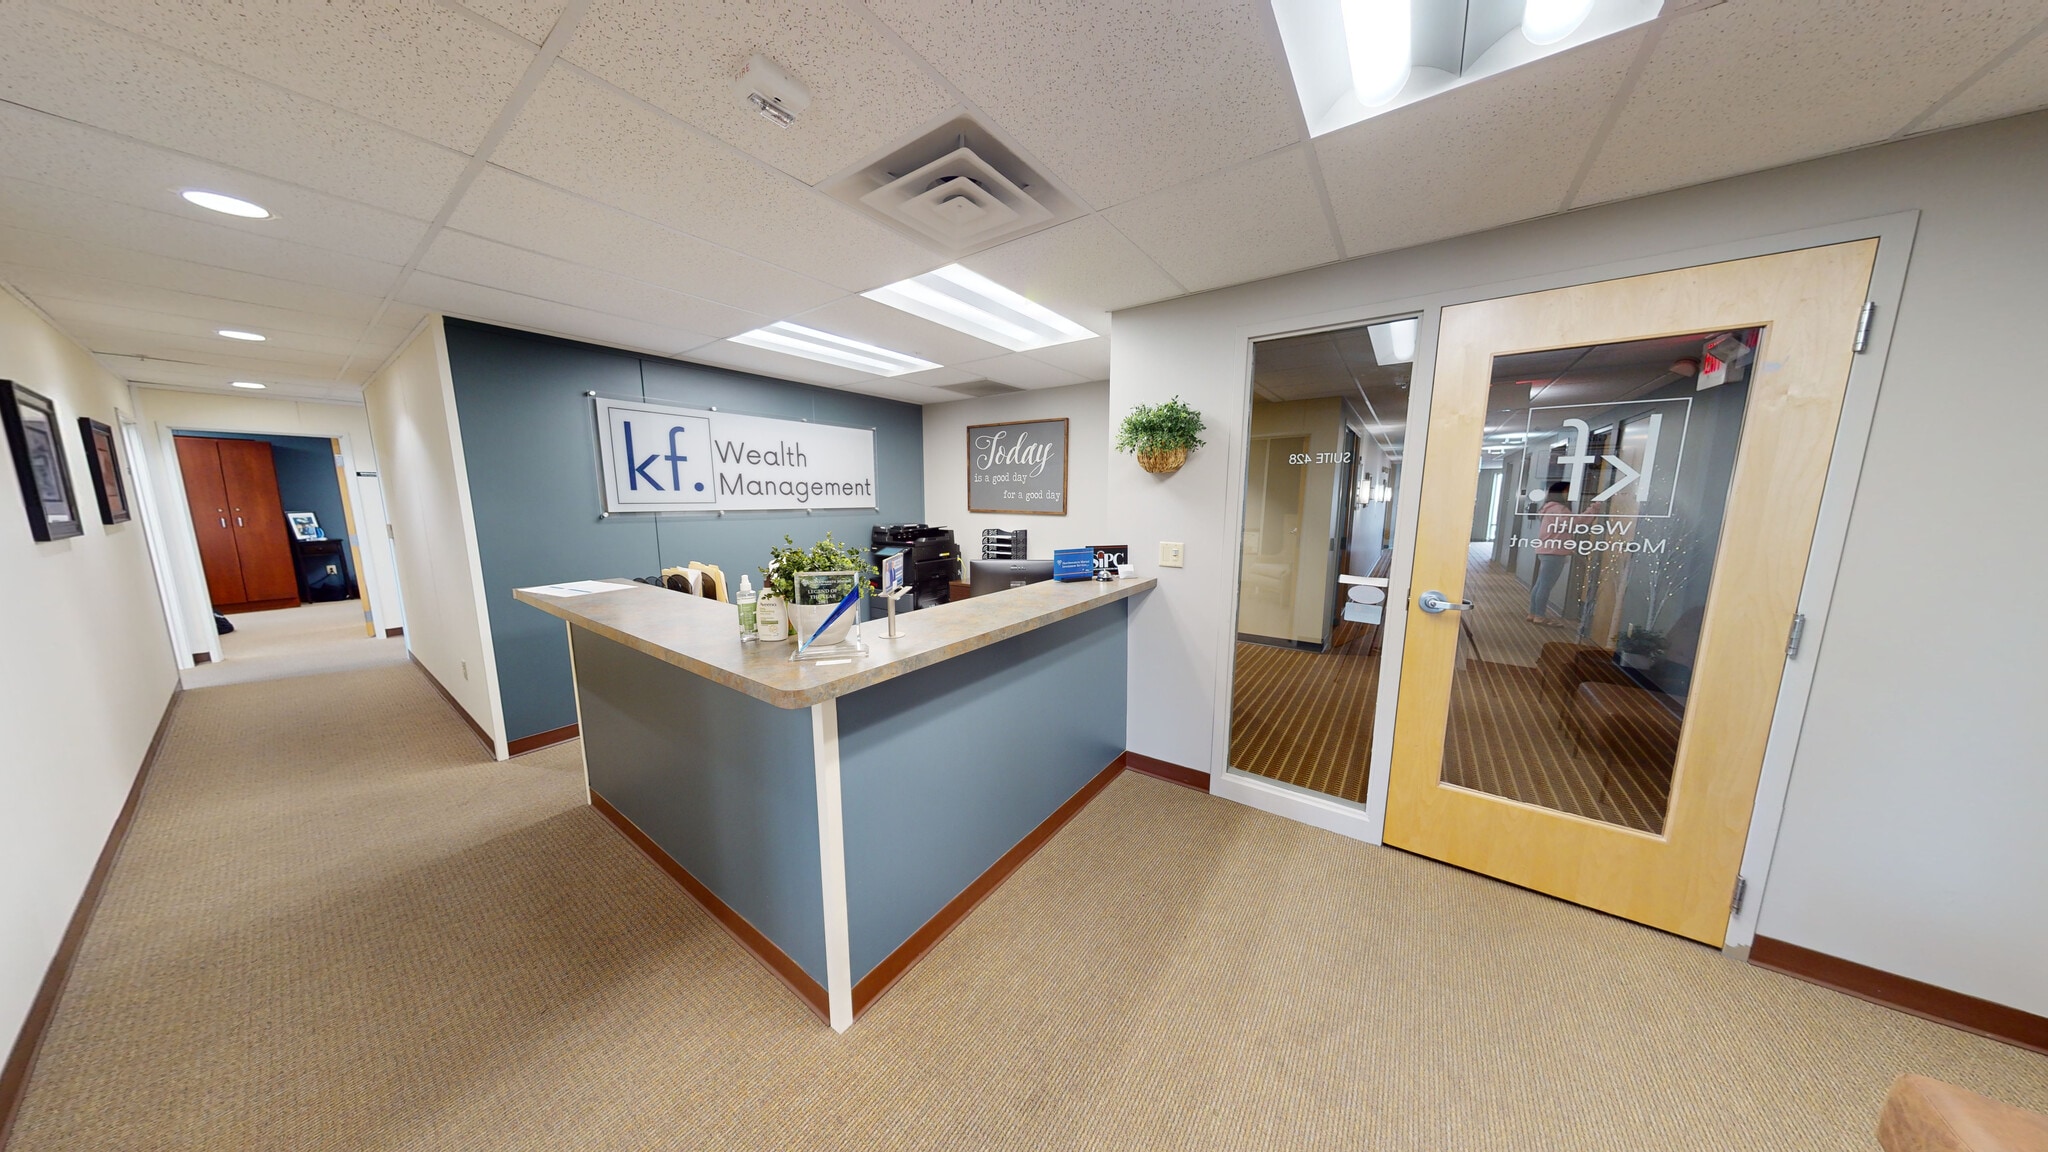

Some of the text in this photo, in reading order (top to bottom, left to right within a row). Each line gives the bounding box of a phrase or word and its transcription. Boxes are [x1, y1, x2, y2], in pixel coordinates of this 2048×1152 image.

[734, 62, 750, 82] FIRE
[714, 439, 808, 468] Wealth
[975, 430, 1055, 478] Today
[719, 472, 872, 503] Management
[974, 471, 1028, 485] is a good day
[1003, 489, 1061, 502] for a good day
